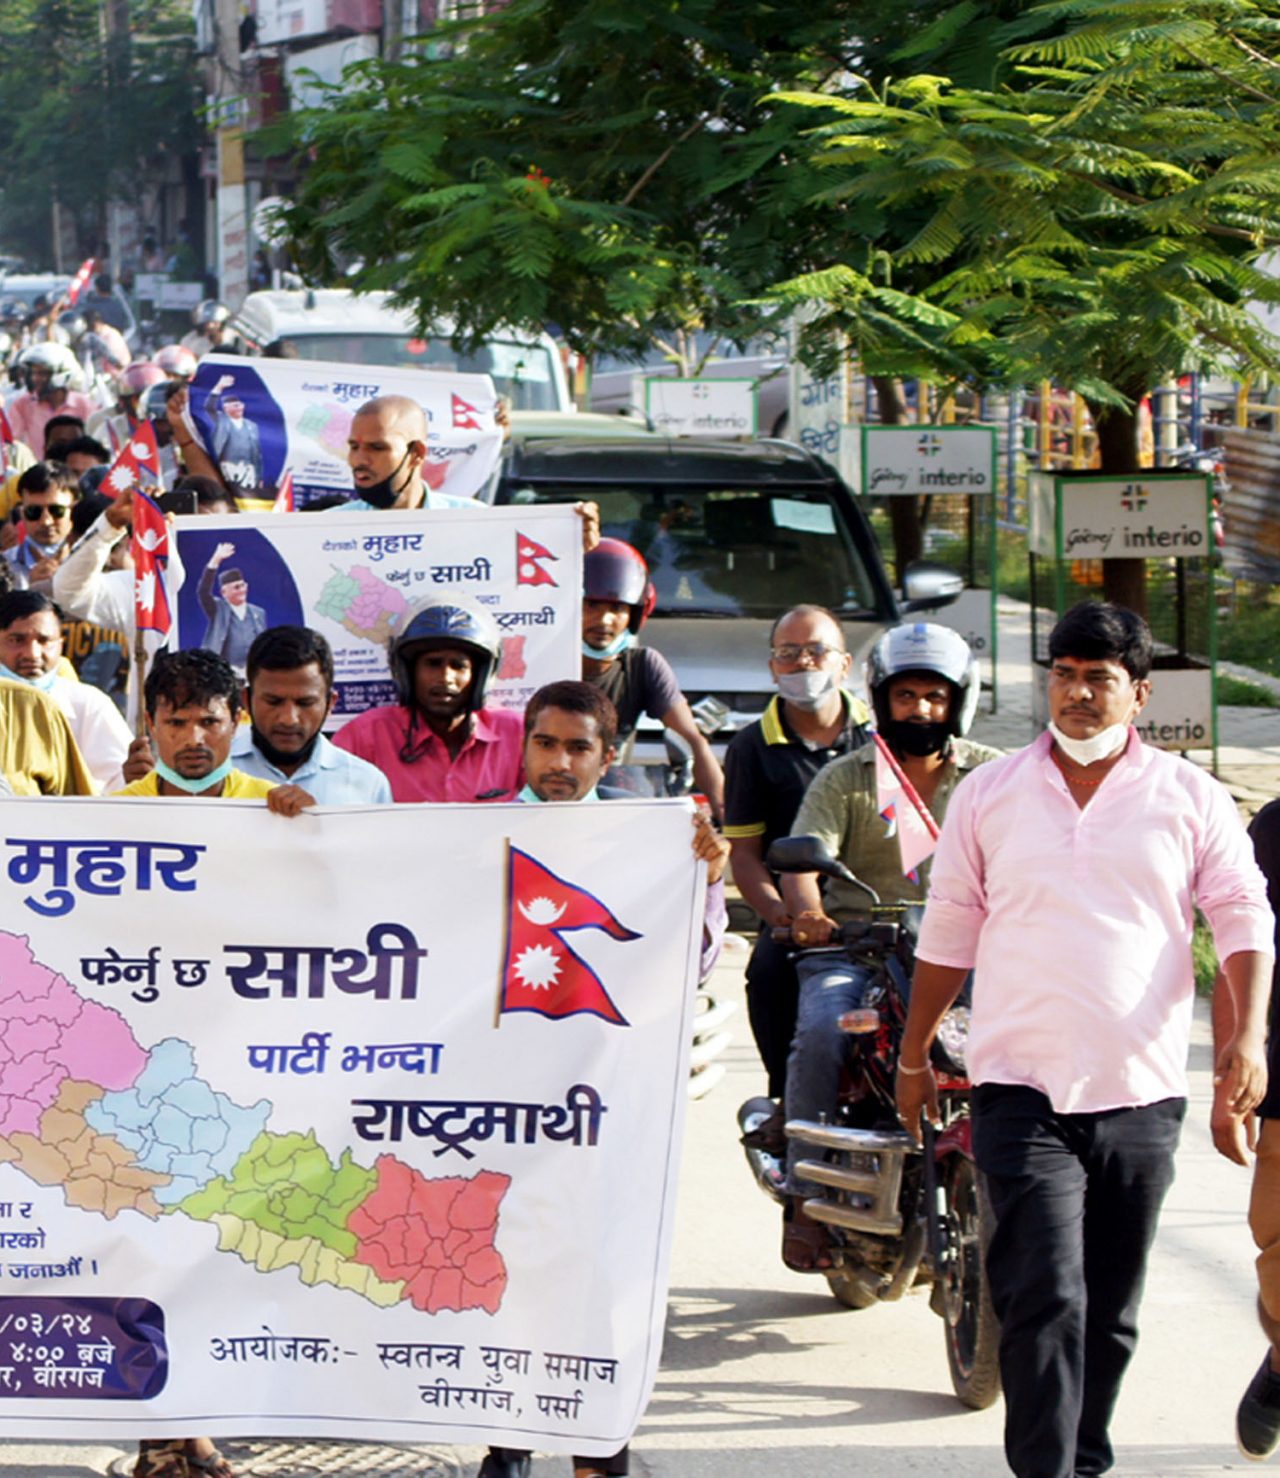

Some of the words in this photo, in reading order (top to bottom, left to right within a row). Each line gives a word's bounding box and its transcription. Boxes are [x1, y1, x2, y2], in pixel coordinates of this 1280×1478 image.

[332, 382, 381, 403] मुहार
[692, 413, 749, 431] interio
[919, 468, 986, 487] interio
[363, 534, 424, 561] मुहार
[1124, 524, 1203, 548] interio
[430, 557, 491, 584] साथी
[1136, 718, 1205, 741] nterio
[5, 838, 207, 918] मुहार
[80, 946, 161, 1003] फेर्नु
[172, 959, 211, 987] छ
[222, 922, 428, 1000] साथी
[247, 1032, 332, 1075] पार्टी
[340, 1042, 444, 1075] भन्दा
[351, 1083, 608, 1160] राष्ट्रमाथी
[19, 1201, 33, 1219] र
[10, 1341, 65, 1364] ४:००
[76, 1335, 117, 1364] बजे
[376, 1342, 465, 1371] स्वतन्त्र
[479, 1345, 532, 1384] युवा
[543, 1352, 620, 1385] समाज
[32, 1359, 107, 1389] वीरगंज
[419, 1378, 523, 1418] वीरगंज,
[535, 1388, 584, 1420] पर्सा
